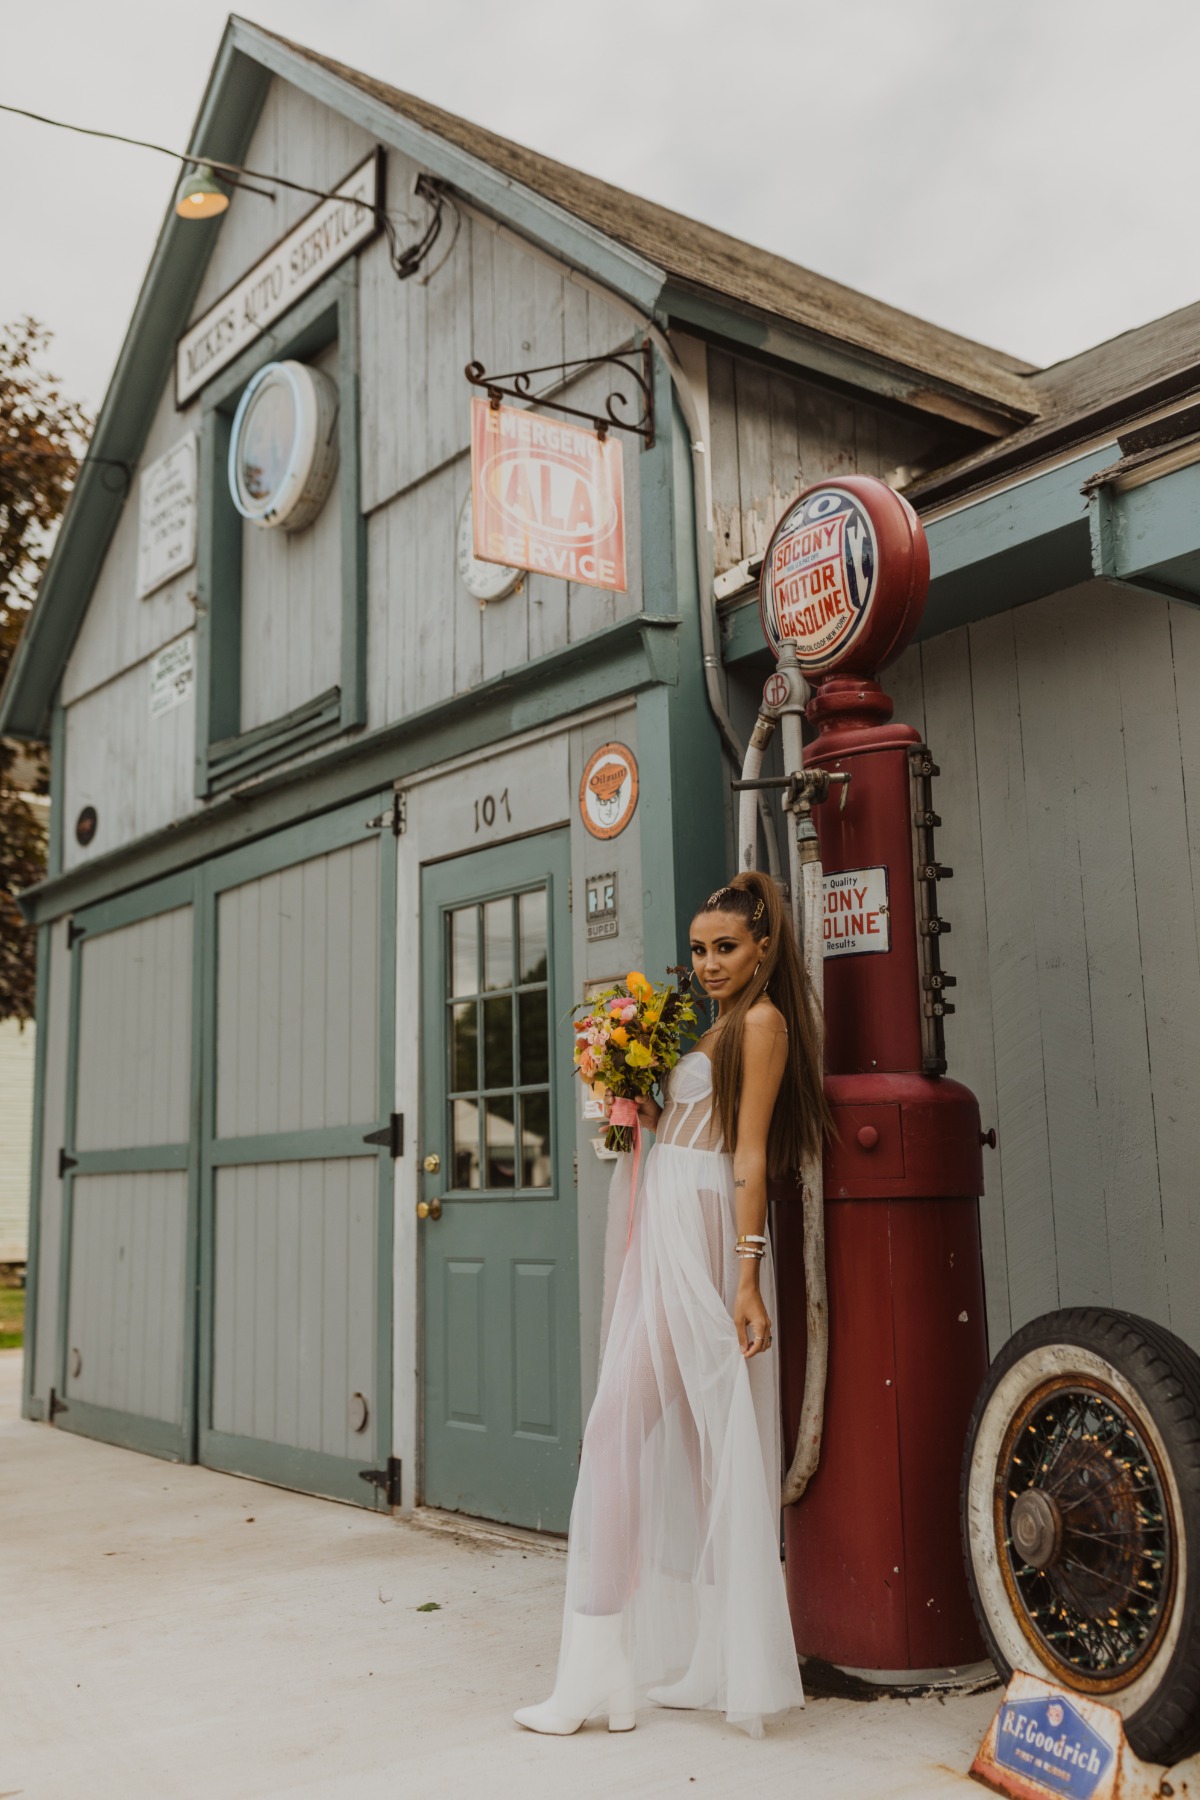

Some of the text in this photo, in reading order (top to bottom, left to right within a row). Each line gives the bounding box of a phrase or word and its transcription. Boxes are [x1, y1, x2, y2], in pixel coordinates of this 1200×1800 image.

[241, 263, 284, 331] AUTO
[289, 184, 366, 285] SERVICE
[504, 463, 595, 532] ALA
[487, 532, 616, 584] SERVICE
[776, 523, 836, 572] SOCONY
[779, 563, 836, 611] MOTOR
[781, 590, 845, 638] GASOLINE
[825, 629, 837, 643] NEW
[835, 614, 848, 631] YORK
[474, 787, 512, 834] 101
[823, 886, 868, 914] ONY
[830, 877, 858, 889] Quality
[587, 922, 615, 937] SUPER
[823, 911, 880, 940] OLINE
[826, 939, 856, 950] Results
